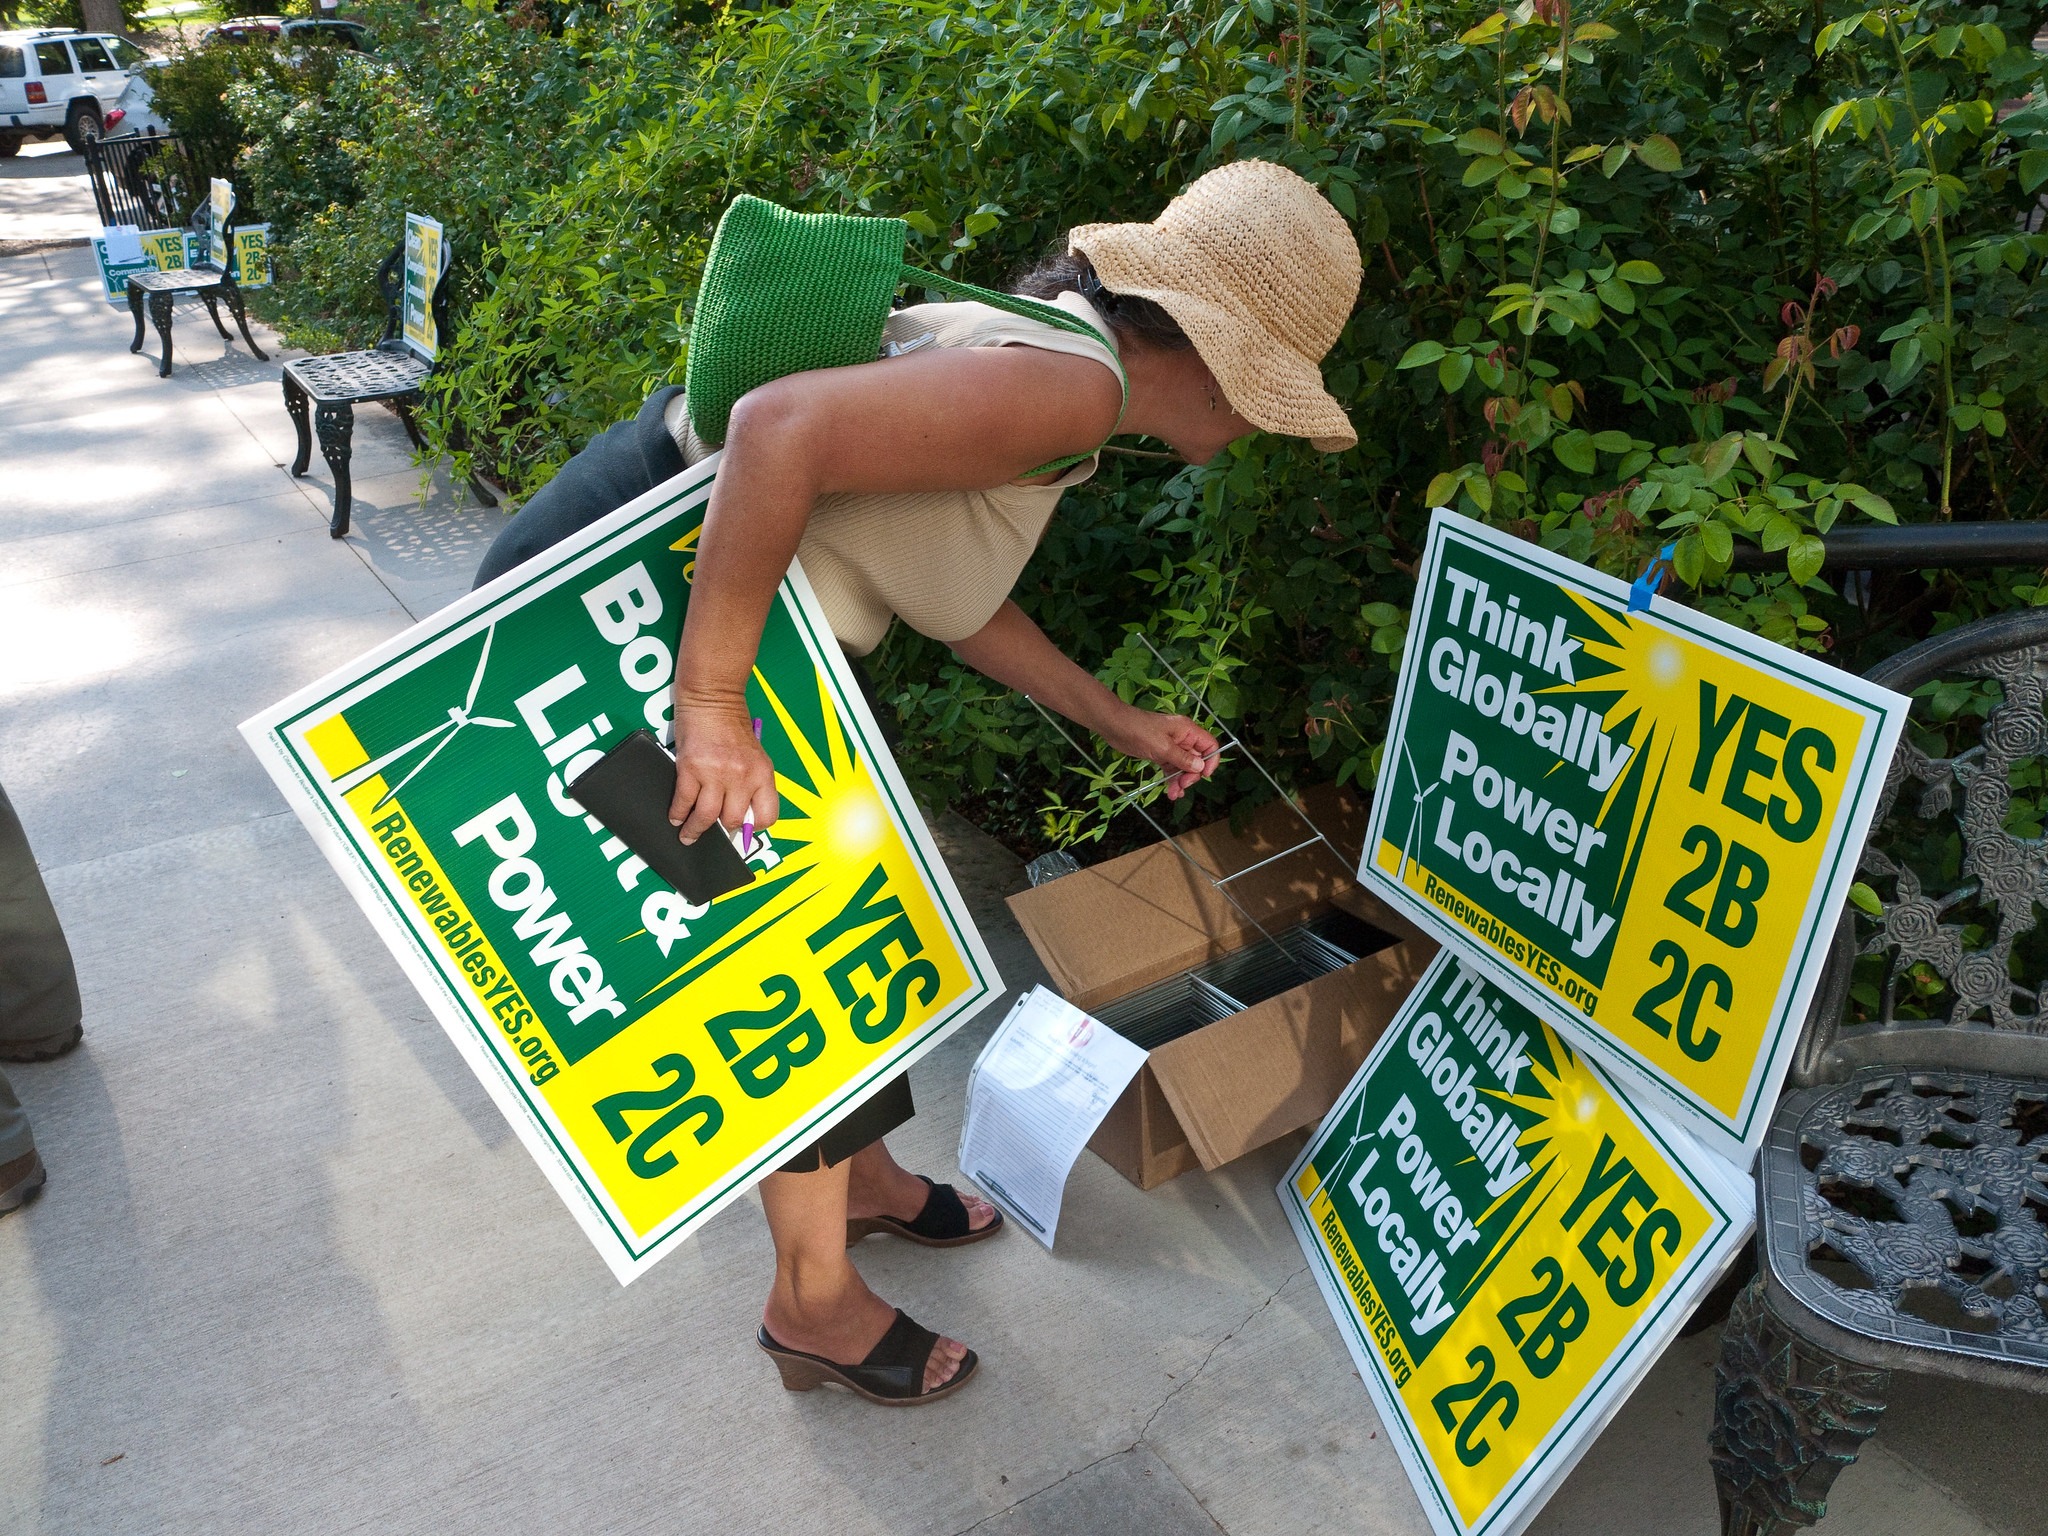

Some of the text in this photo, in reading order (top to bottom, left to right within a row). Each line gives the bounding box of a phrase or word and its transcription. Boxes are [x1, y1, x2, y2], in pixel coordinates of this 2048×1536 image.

[108, 265, 160, 277] Community
[155, 236, 183, 253] YES
[164, 254, 182, 270] 2B
[240, 233, 264, 250] YES
[1444, 564, 1585, 687] Think
[266, 731, 276, 742] Paid
[282, 754, 296, 772] Citizens
[298, 778, 314, 798] Boulder's
[311, 798, 323, 812] Clean
[1428, 637, 1635, 794] Globally
[1688, 678, 1838, 844] YES
[1439, 728, 1607, 868] Power
[372, 813, 561, 1087] RenewablesYES.org
[451, 791, 628, 1027] Power
[640, 890, 711, 960] &
[1423, 873, 1599, 1018] RenewablesYES.org
[1433, 801, 1617, 960] Locally
[1663, 824, 1771, 949] 2B
[807, 863, 941, 1046] YES
[1632, 937, 1735, 1063] 2C
[704, 973, 827, 1100] 2B
[1440, 954, 1535, 1097] Think
[592, 1052, 725, 1181] 2C
[1407, 1011, 1534, 1198] Globally
[1347, 1148, 1456, 1338] Locally
[1376, 1093, 1481, 1258] Power
[1560, 1133, 1683, 1309] YES
[1321, 1209, 1412, 1391] RenewablesYES.org
[1496, 1255, 1590, 1381] 2B
[1430, 1344, 1520, 1468] 2C
